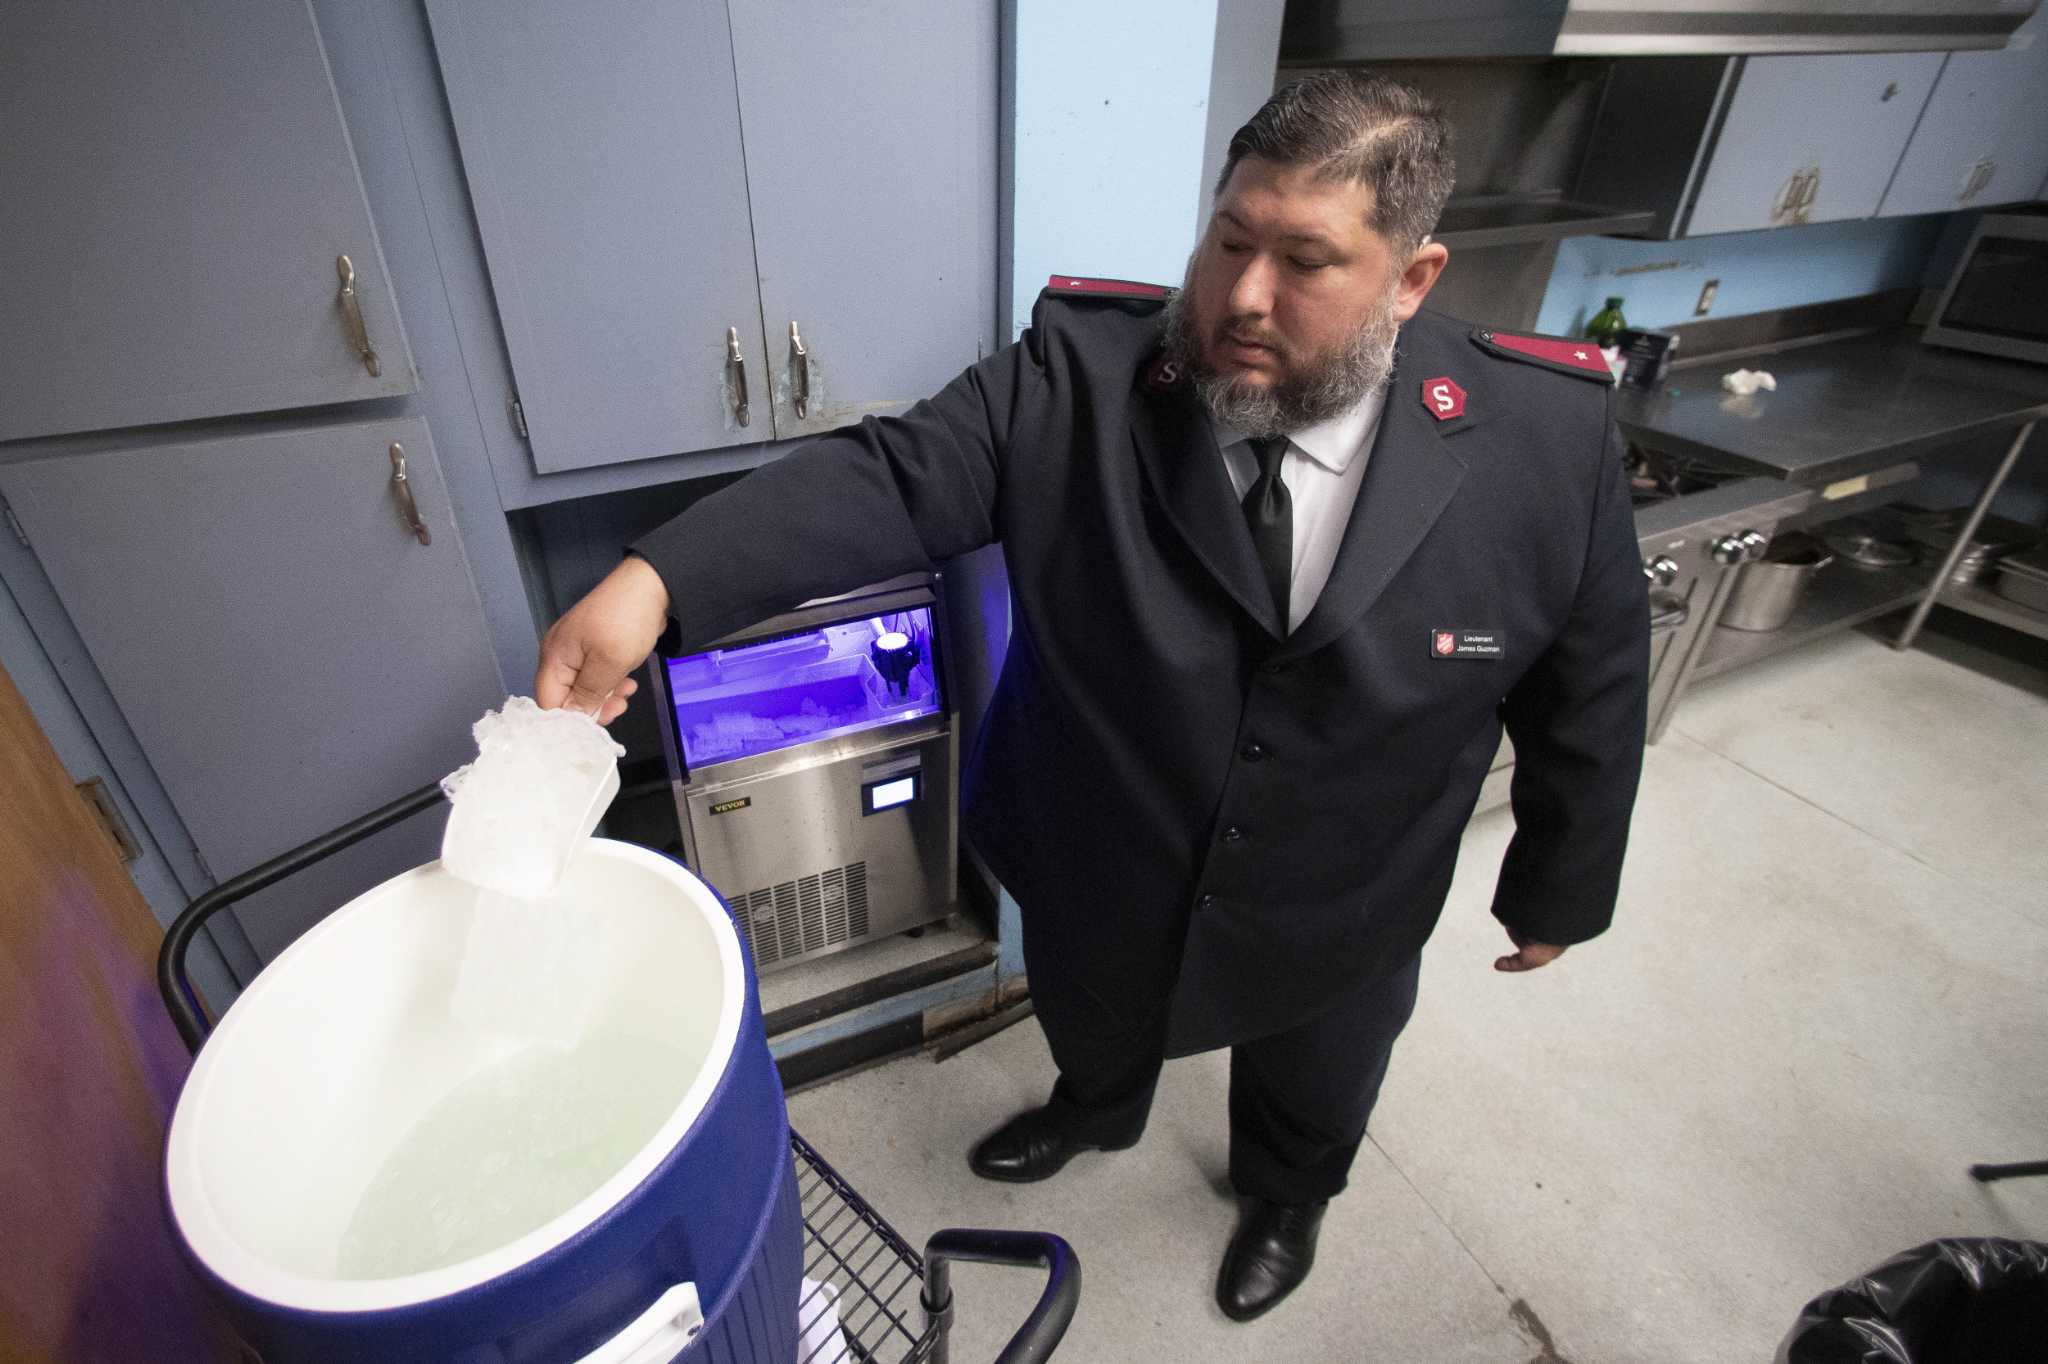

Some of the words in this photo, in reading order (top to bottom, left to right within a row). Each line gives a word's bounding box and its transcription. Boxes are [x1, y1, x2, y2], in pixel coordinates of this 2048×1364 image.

[1158, 361, 1177, 384] S
[1432, 385, 1454, 412] S
[1463, 635, 1493, 643] Lieutenant
[1457, 644, 1476, 653] James
[714, 800, 745, 812] VEVOR
